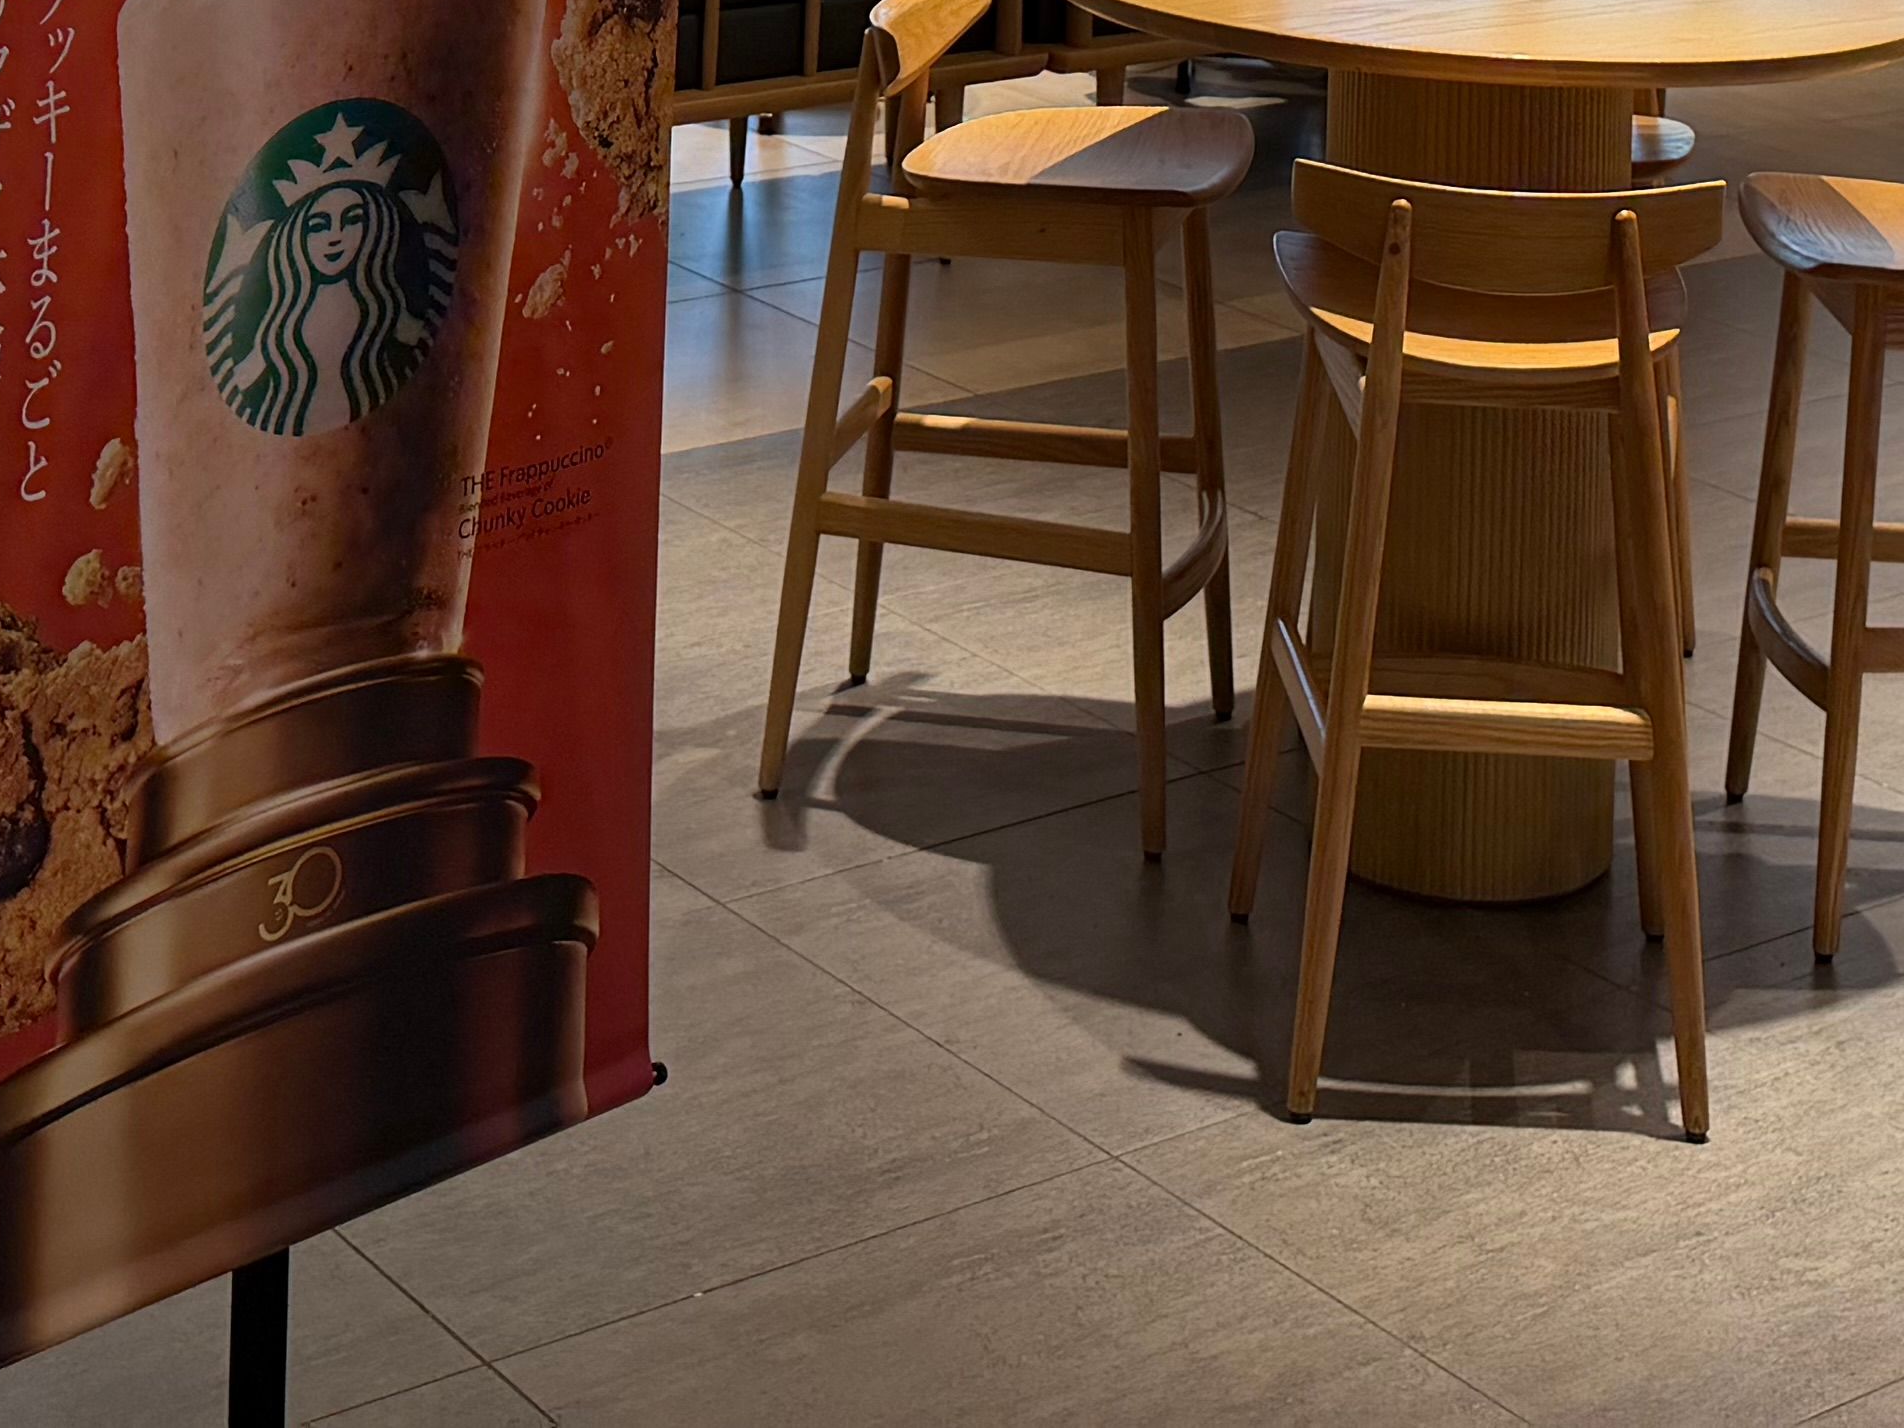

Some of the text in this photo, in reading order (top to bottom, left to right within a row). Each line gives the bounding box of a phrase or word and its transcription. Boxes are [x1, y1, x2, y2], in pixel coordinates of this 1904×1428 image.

[461, 471, 496, 497] THE
[458, 504, 527, 540] Chunky
[531, 487, 592, 519] Cookie
[257, 845, 343, 943] 30
